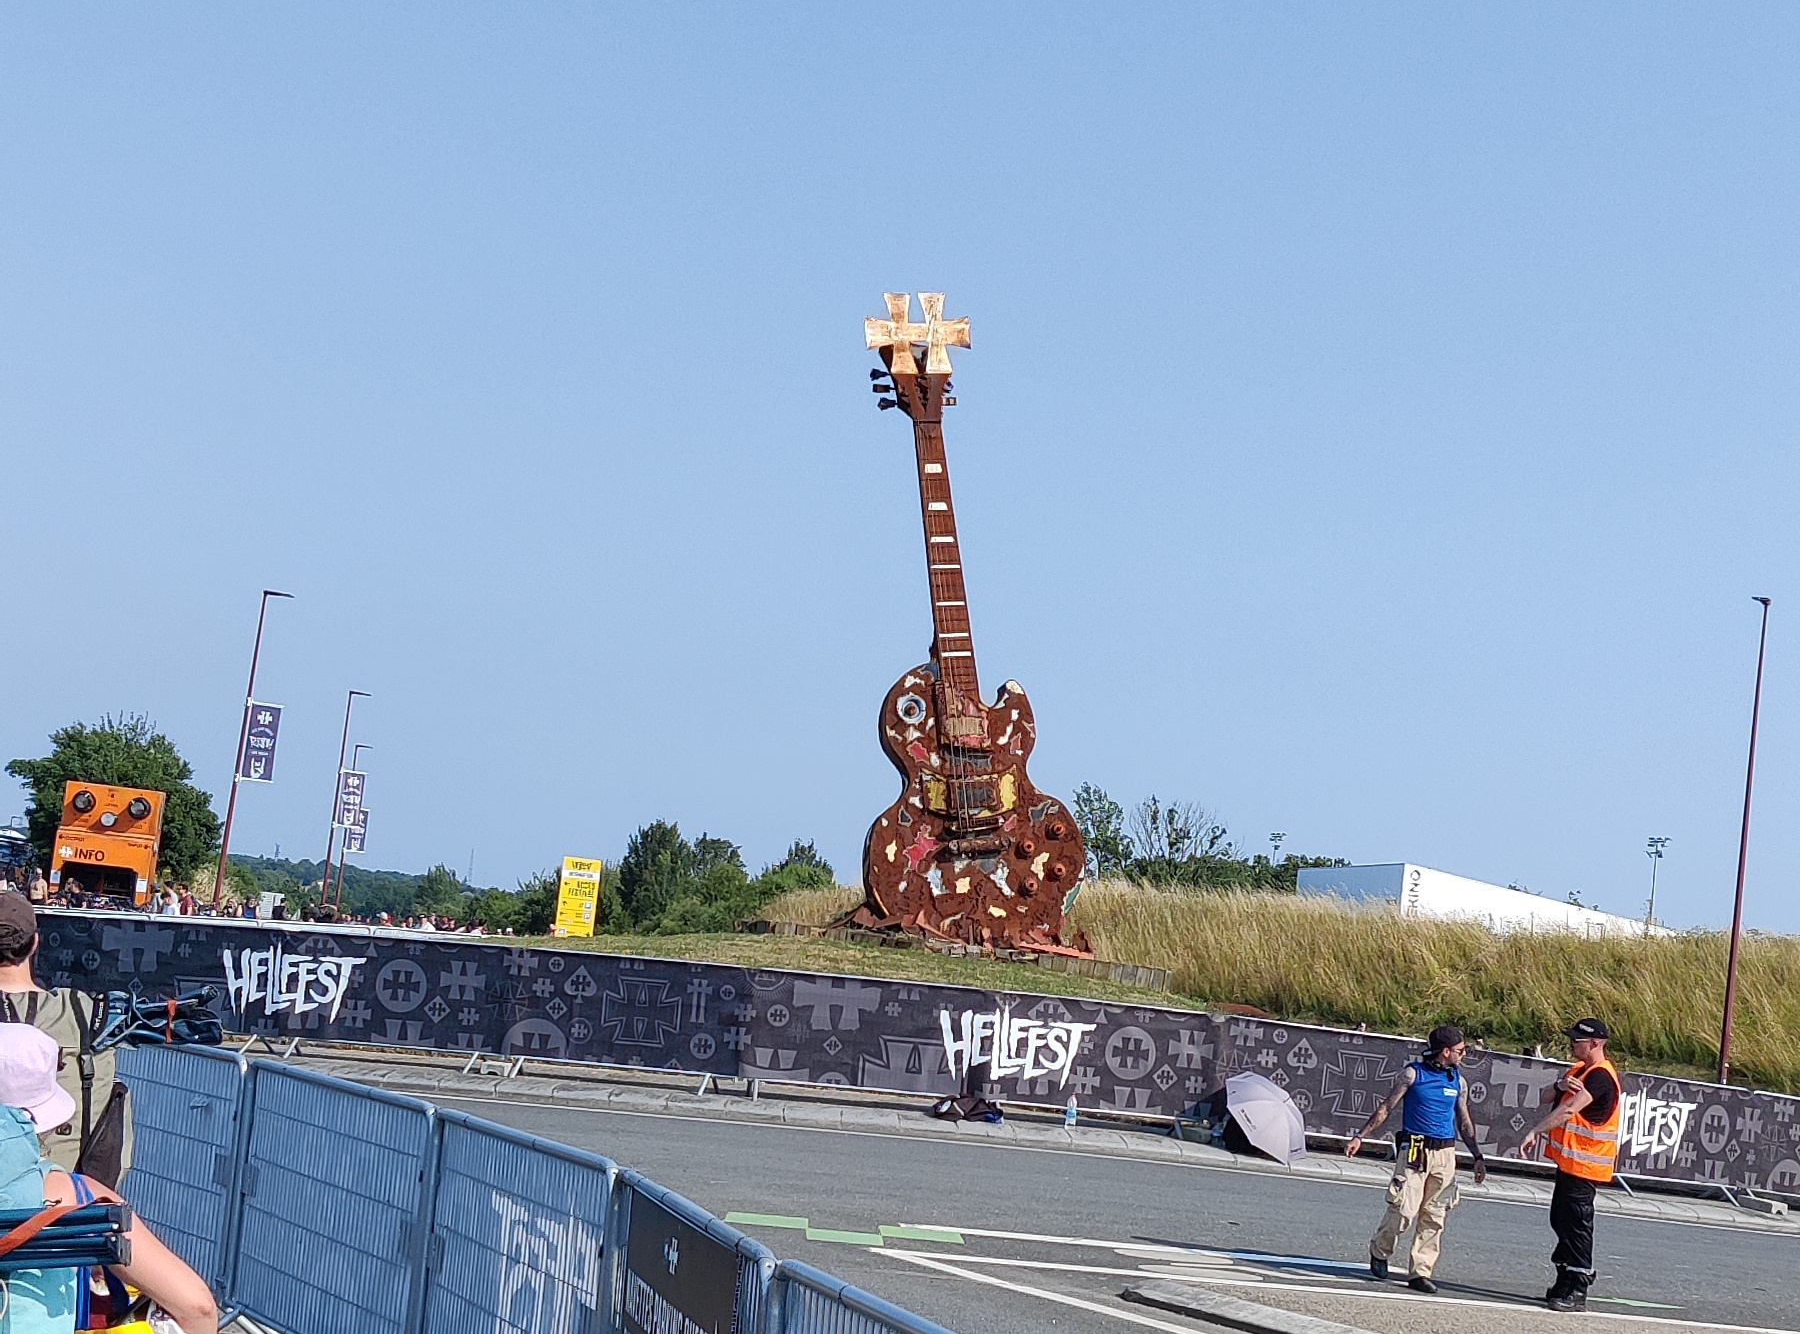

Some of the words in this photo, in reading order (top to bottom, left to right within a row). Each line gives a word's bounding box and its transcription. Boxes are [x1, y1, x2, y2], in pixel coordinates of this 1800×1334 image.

[73, 847, 105, 862] INFO
[222, 941, 368, 1025] HELLFEST
[939, 1004, 1098, 1091] HELLFEST
